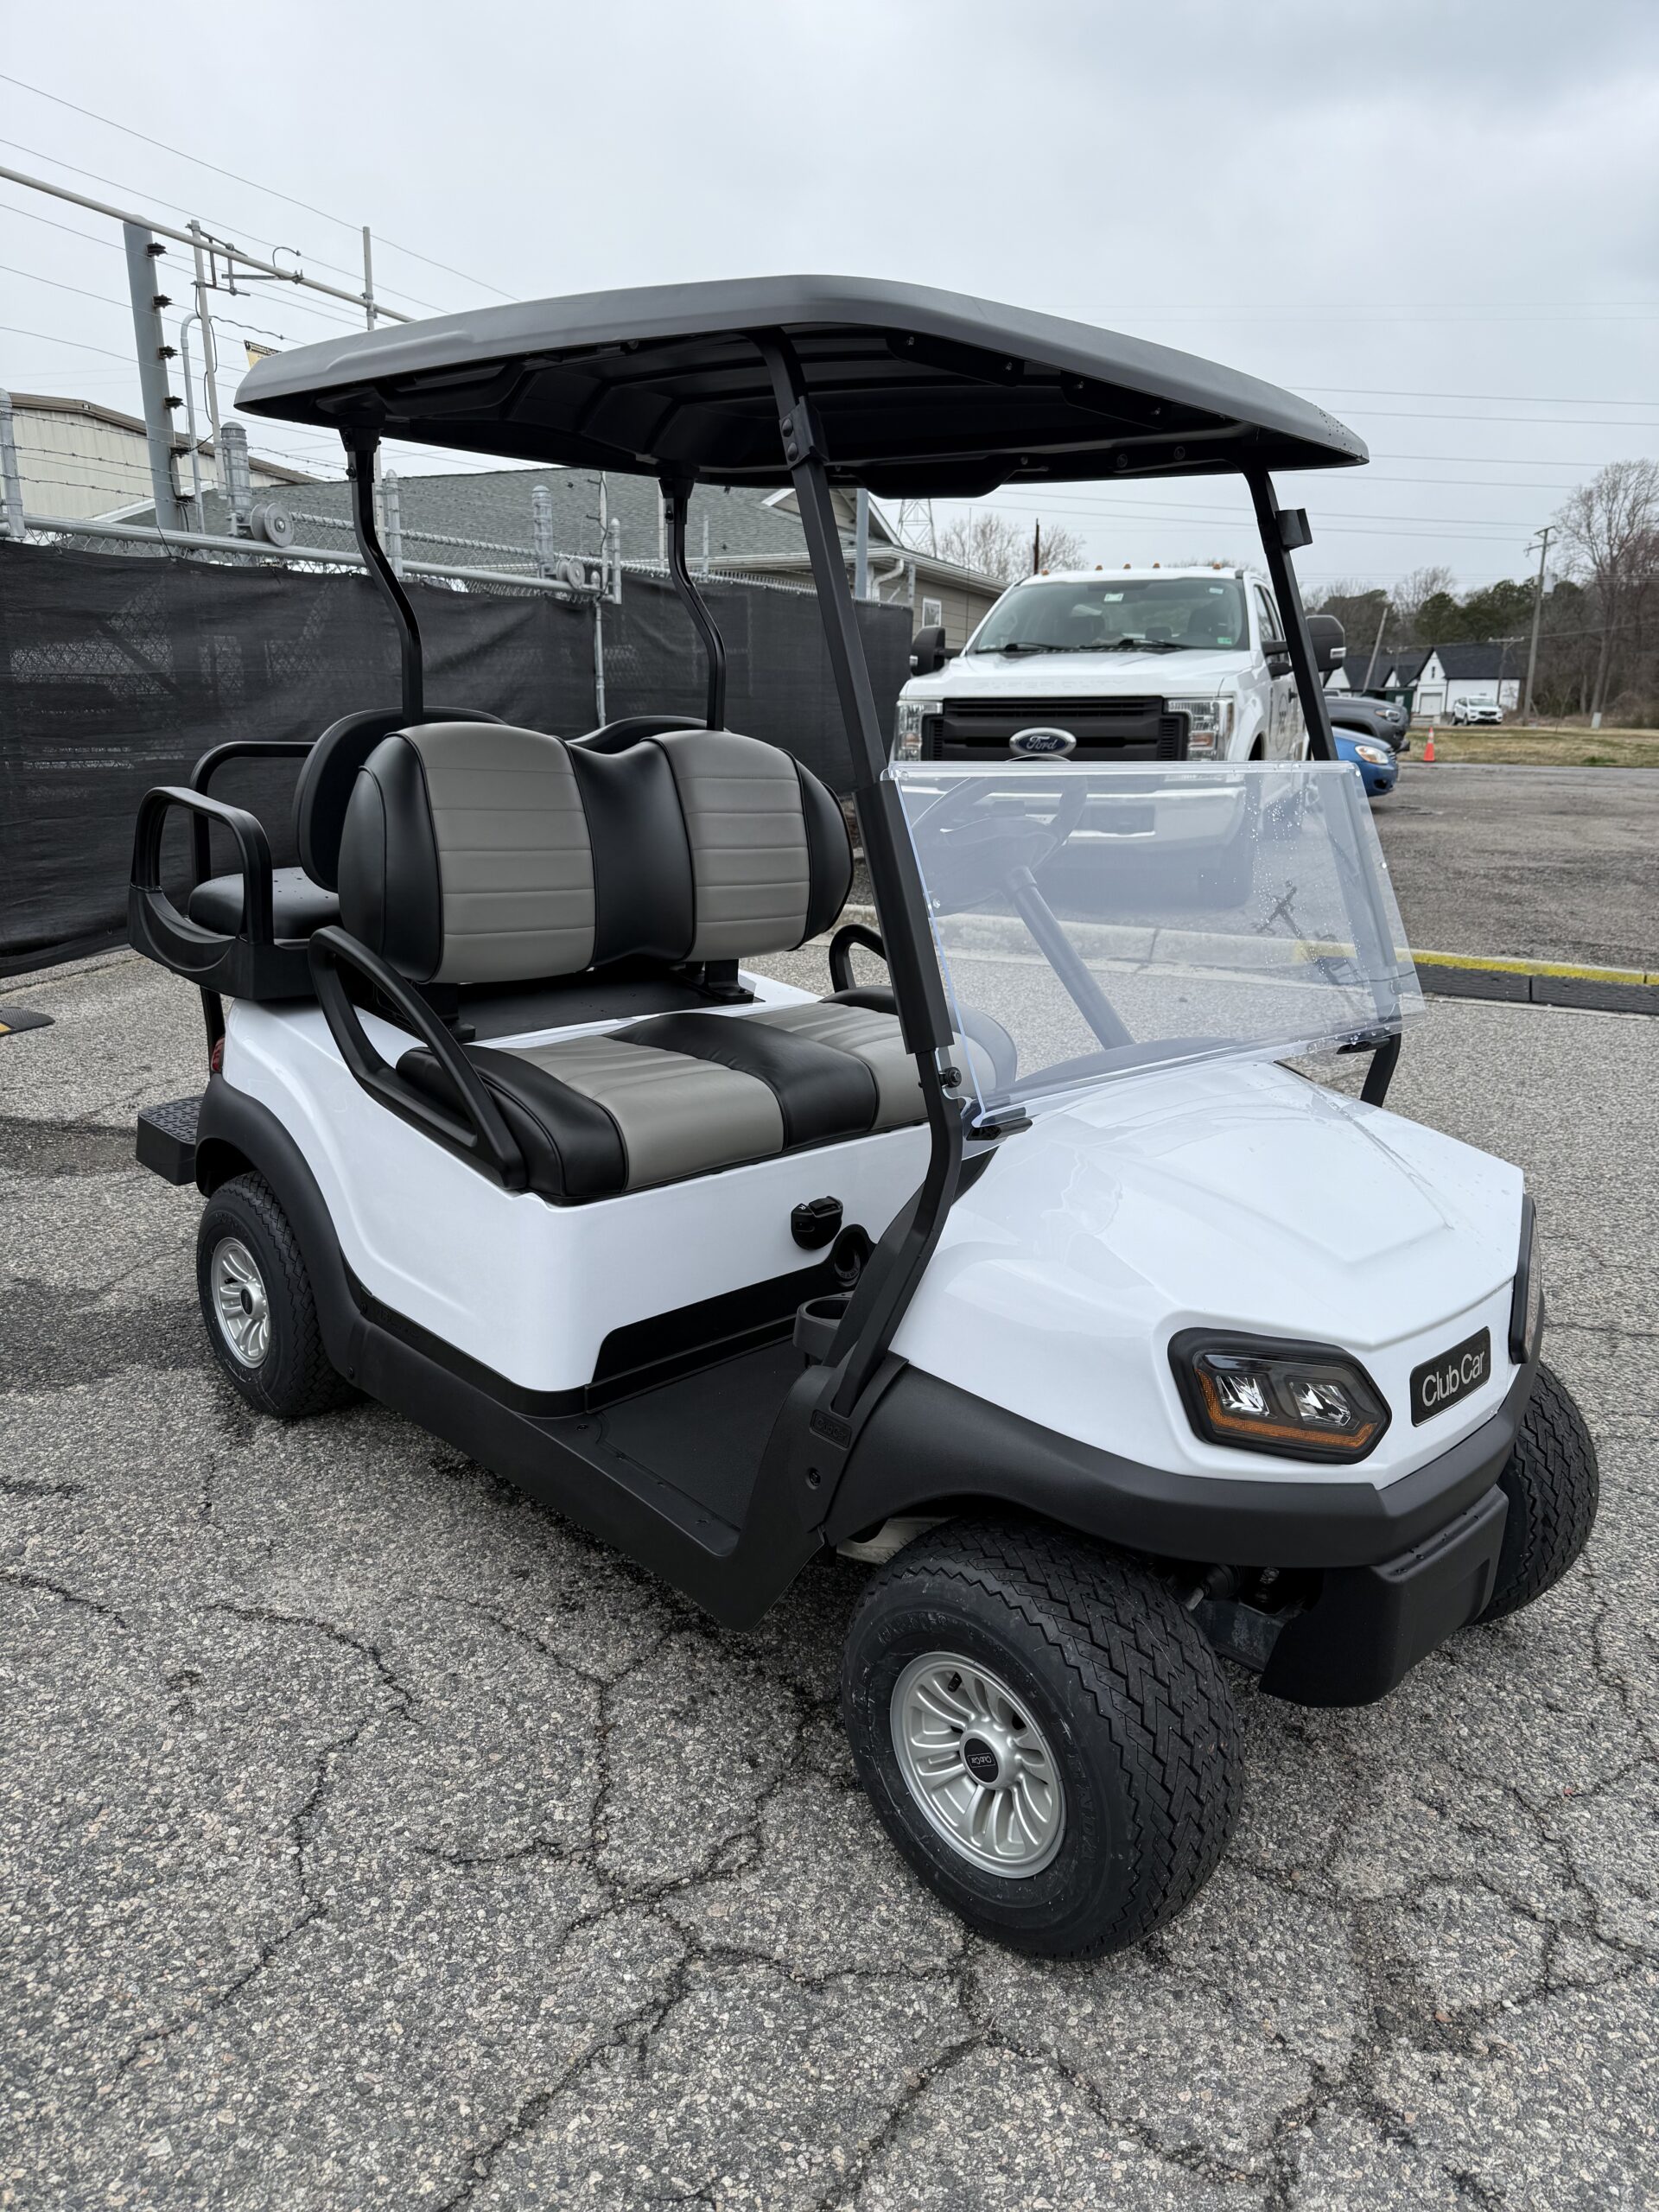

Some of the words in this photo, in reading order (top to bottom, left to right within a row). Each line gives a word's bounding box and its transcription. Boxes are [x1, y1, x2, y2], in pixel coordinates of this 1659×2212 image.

[1026, 735, 1058, 750] Ford
[1421, 1365, 1459, 1407] Club
[1460, 1351, 1485, 1384] Car
